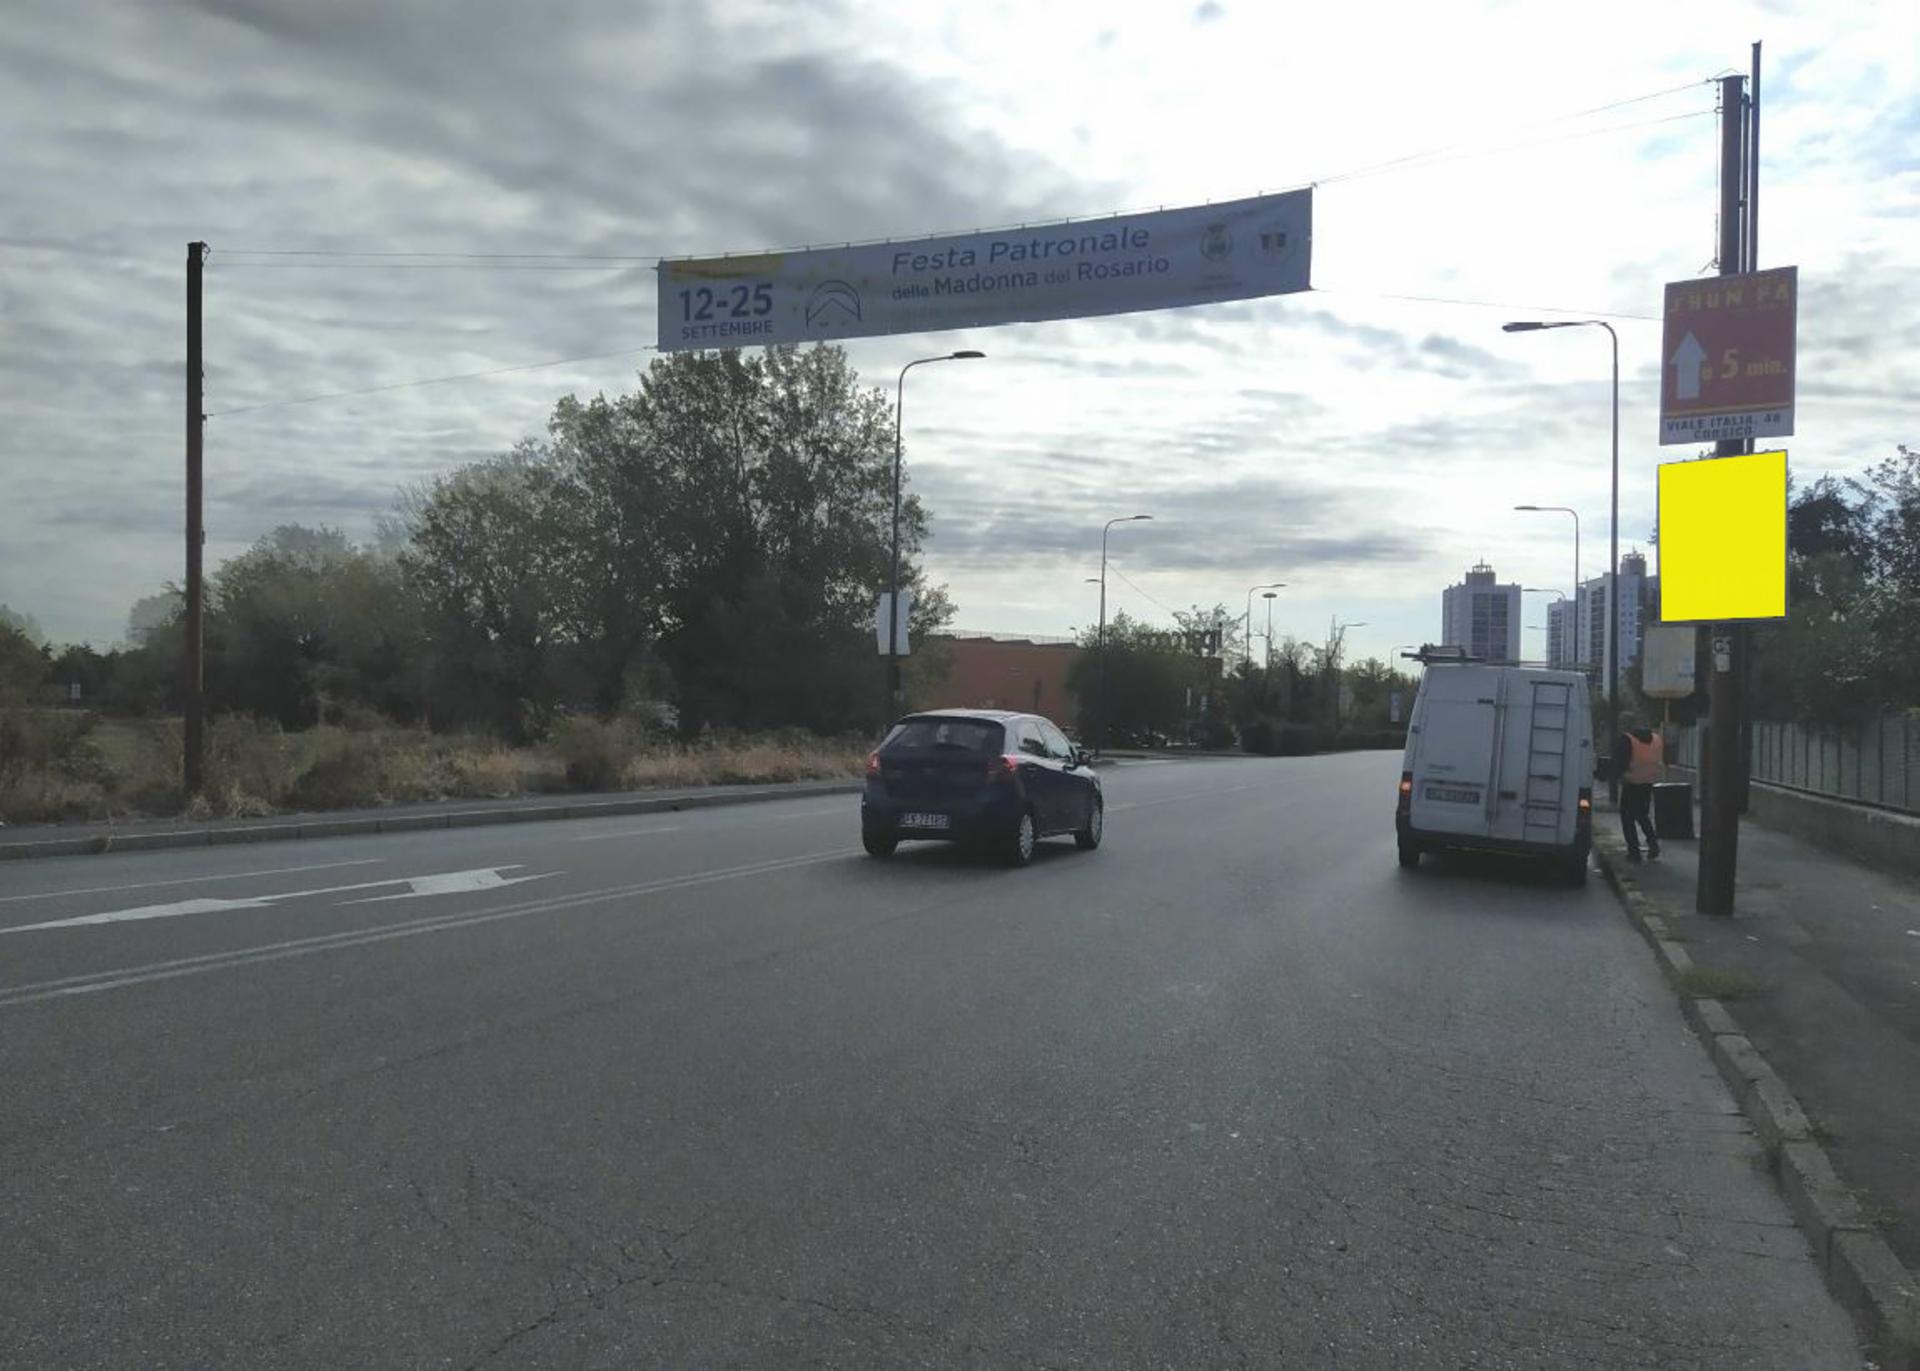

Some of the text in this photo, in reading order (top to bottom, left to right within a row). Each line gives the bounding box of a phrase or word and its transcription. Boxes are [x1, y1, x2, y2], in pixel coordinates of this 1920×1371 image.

[892, 226, 1149, 275] Festa Patronale
[934, 270, 1038, 296] Madonna
[1043, 268, 1071, 285] del
[1077, 256, 1170, 281] Rosario
[679, 283, 773, 321] 12-25
[681, 319, 773, 339] SETTEMBRE
[1721, 348, 1740, 379] 5
[1667, 418, 1704, 431] VIALE
